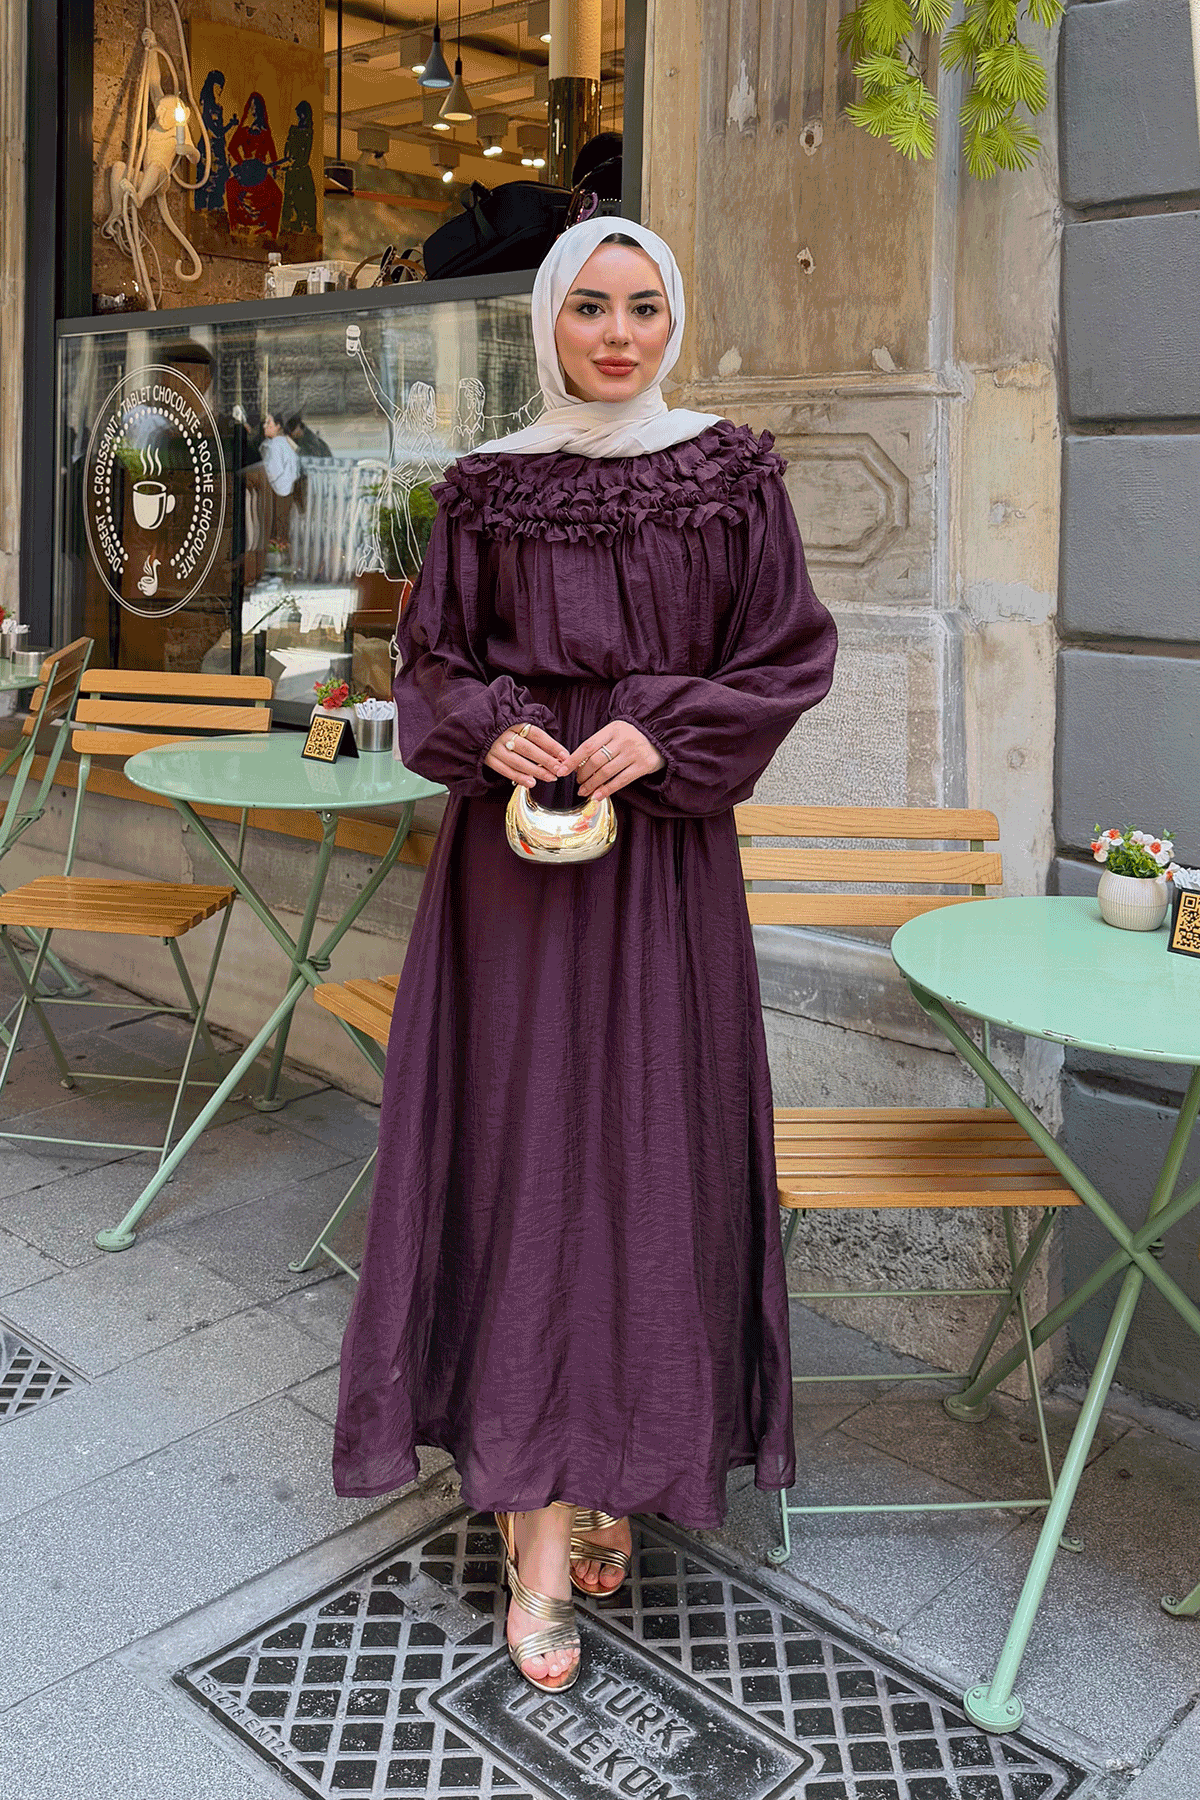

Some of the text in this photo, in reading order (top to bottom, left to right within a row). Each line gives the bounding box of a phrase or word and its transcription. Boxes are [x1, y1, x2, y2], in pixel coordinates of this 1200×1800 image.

[94, 384, 214, 579] DESSERT CROISSANT TABLET CHOCOLATE ROCHE CHOCOLATE
[584, 1672, 692, 1752] TÜRK
